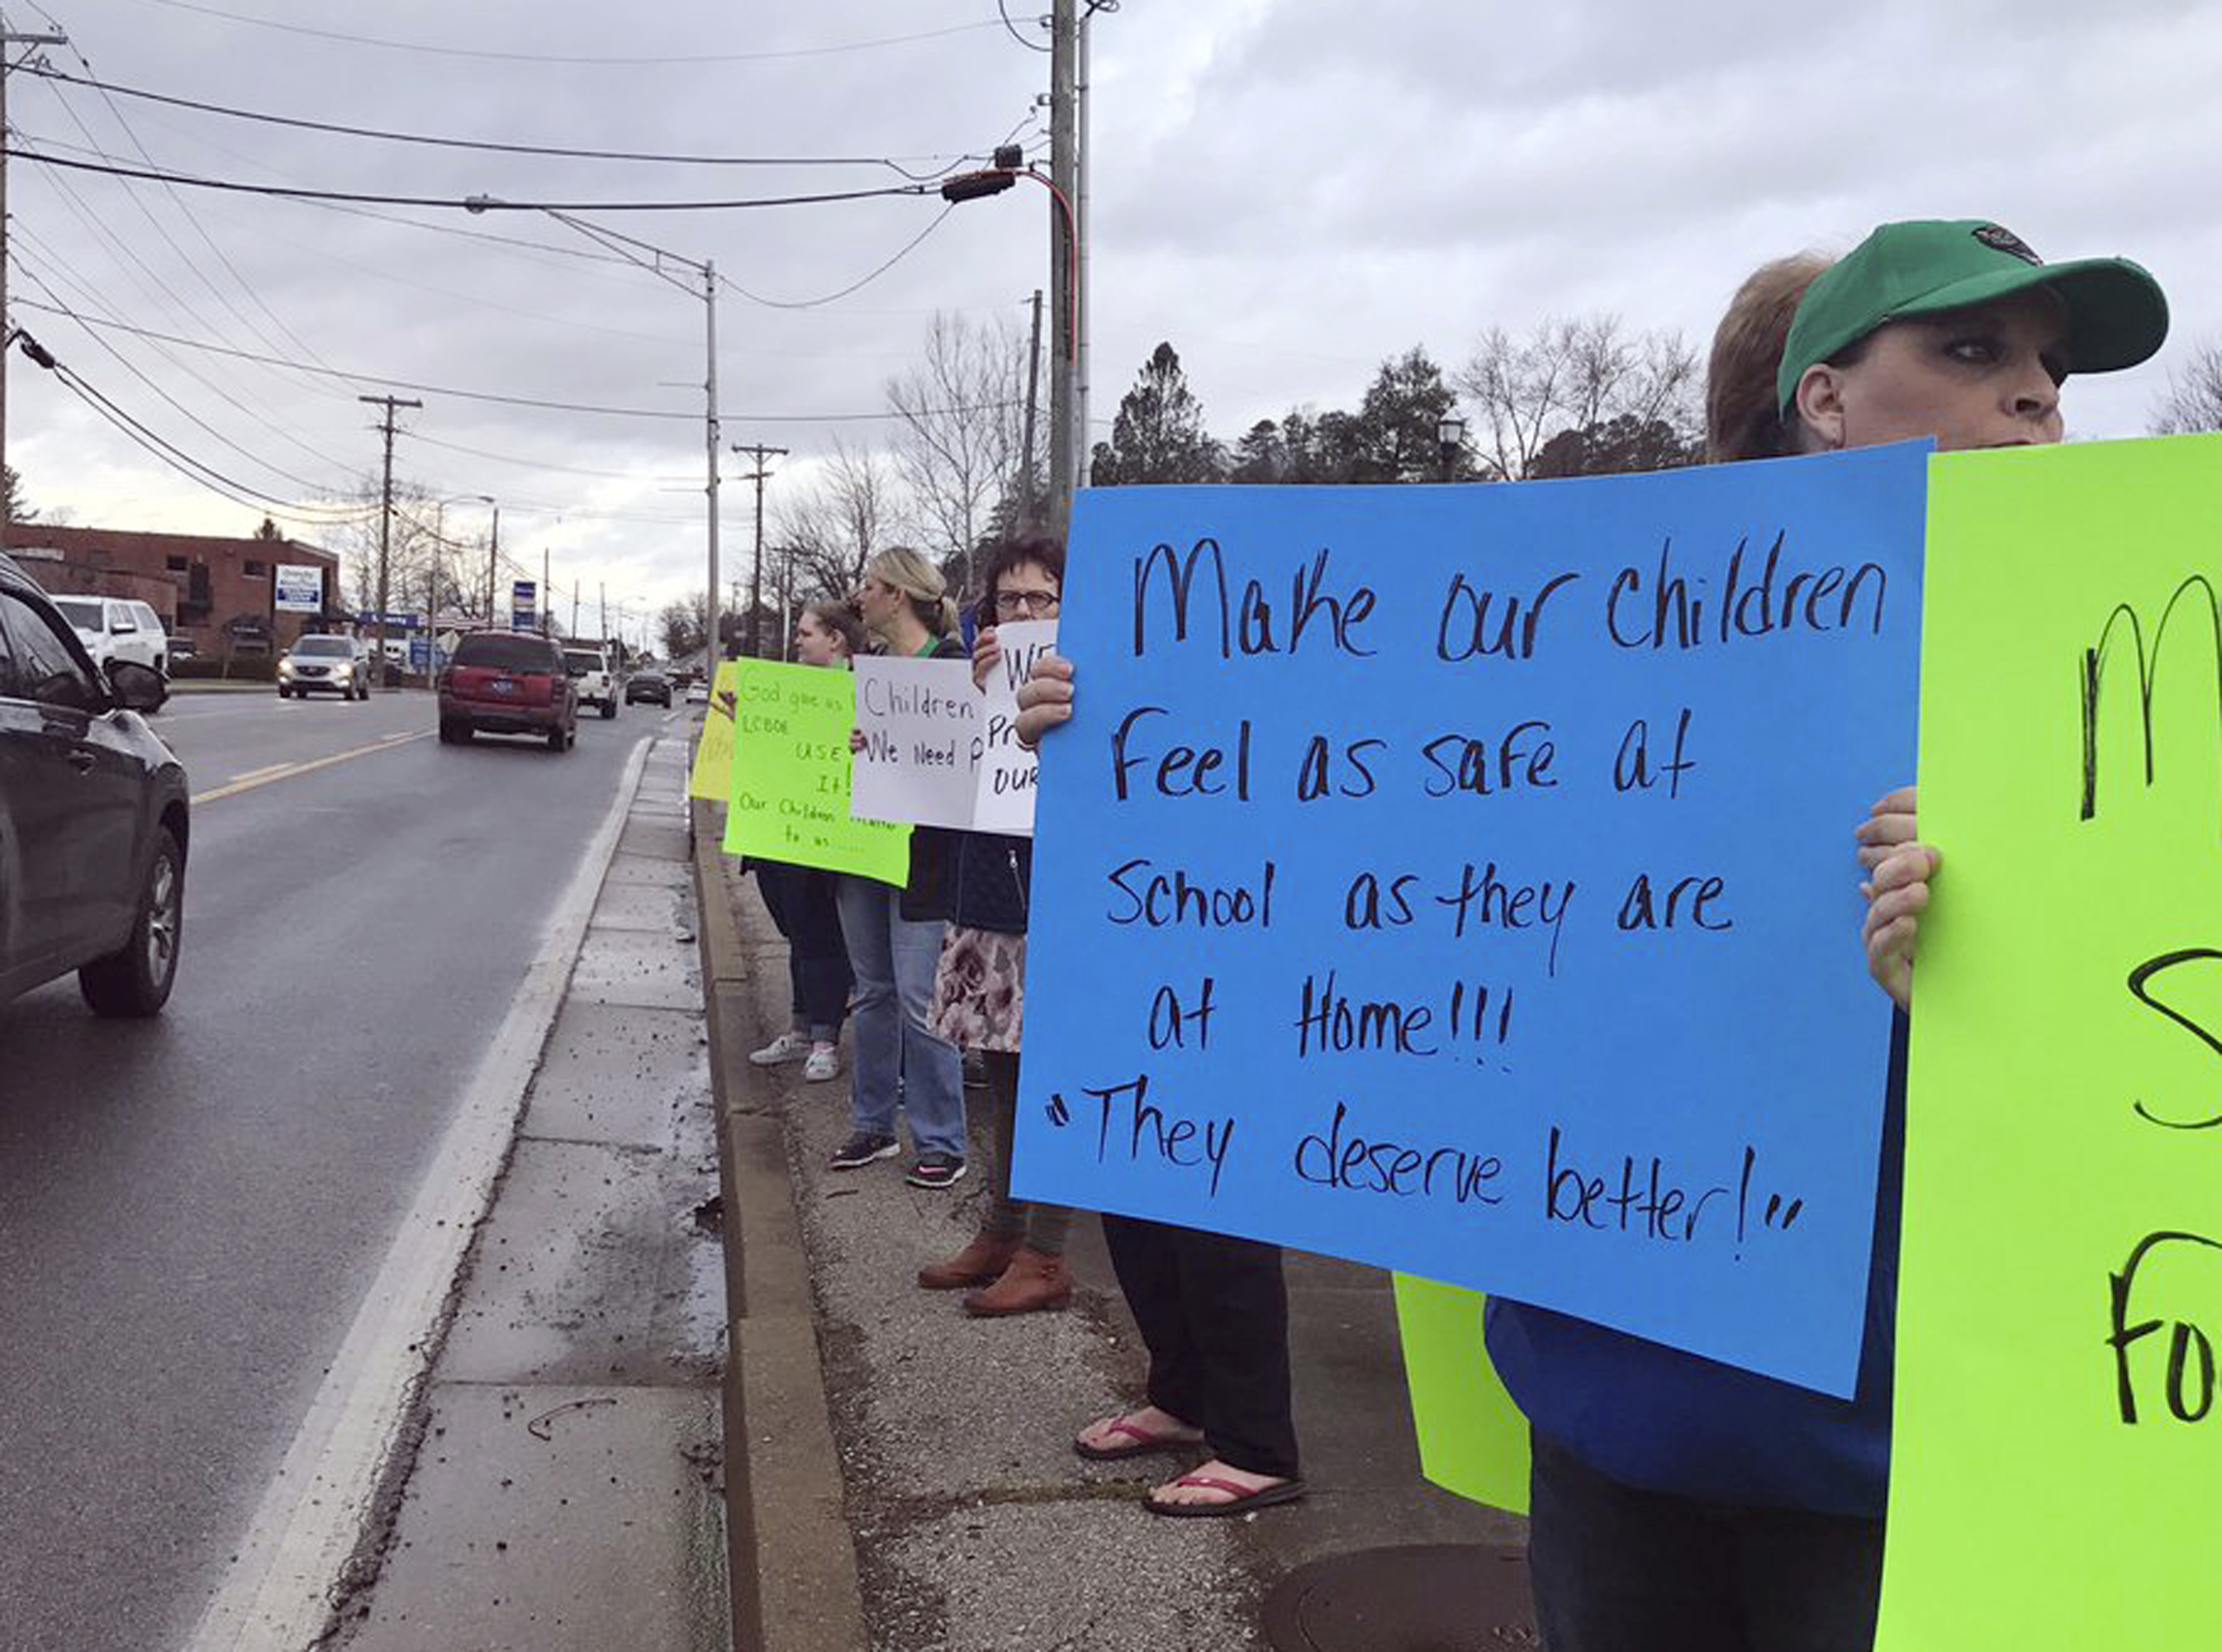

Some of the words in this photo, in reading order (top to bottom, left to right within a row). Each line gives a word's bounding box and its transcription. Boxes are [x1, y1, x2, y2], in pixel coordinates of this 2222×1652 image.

[1133, 537, 1378, 661] Make
[1436, 572, 1581, 662] our
[865, 676, 975, 719] Children
[867, 730, 899, 763] We
[914, 738, 955, 769] Need
[1296, 733, 1388, 803] as
[1422, 719, 1559, 799] safe
[1612, 707, 1696, 800] at
[1107, 857, 1275, 928] School
[1343, 871, 1419, 931] as
[1434, 861, 1575, 978] they
[1616, 873, 1733, 932] are
[1147, 976, 1215, 1051] at
[1294, 968, 1513, 1074] Home!!!
[1294, 1100, 1503, 1206] deserve
